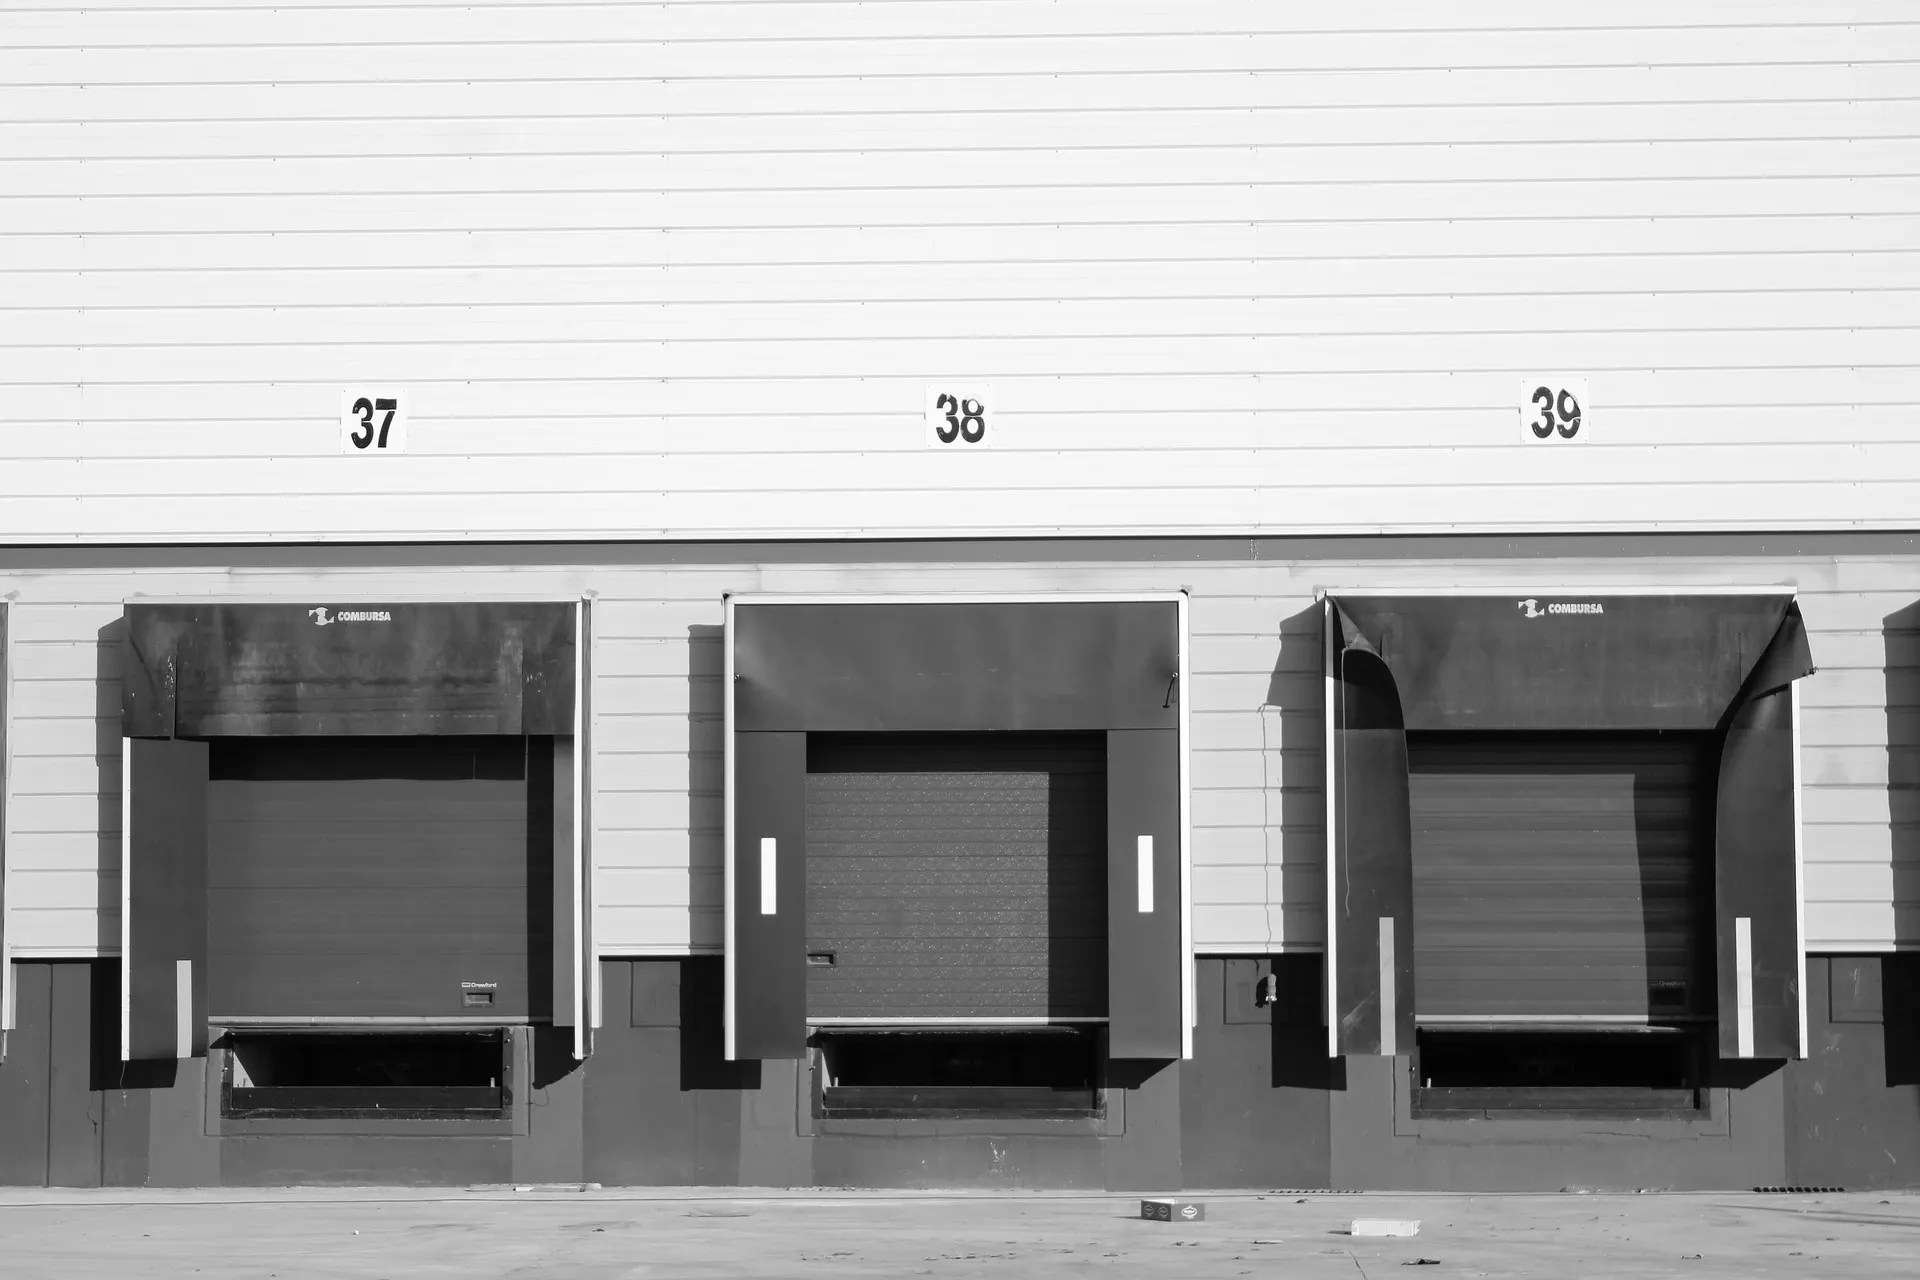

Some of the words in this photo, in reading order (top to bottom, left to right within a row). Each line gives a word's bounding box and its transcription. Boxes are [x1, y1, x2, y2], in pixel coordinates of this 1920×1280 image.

[351, 397, 397, 449] 37
[936, 393, 985, 443] 38
[1531, 386, 1581, 439] 39
[337, 611, 392, 621] COMBURSA
[1548, 603, 1604, 614] COMBURSA
